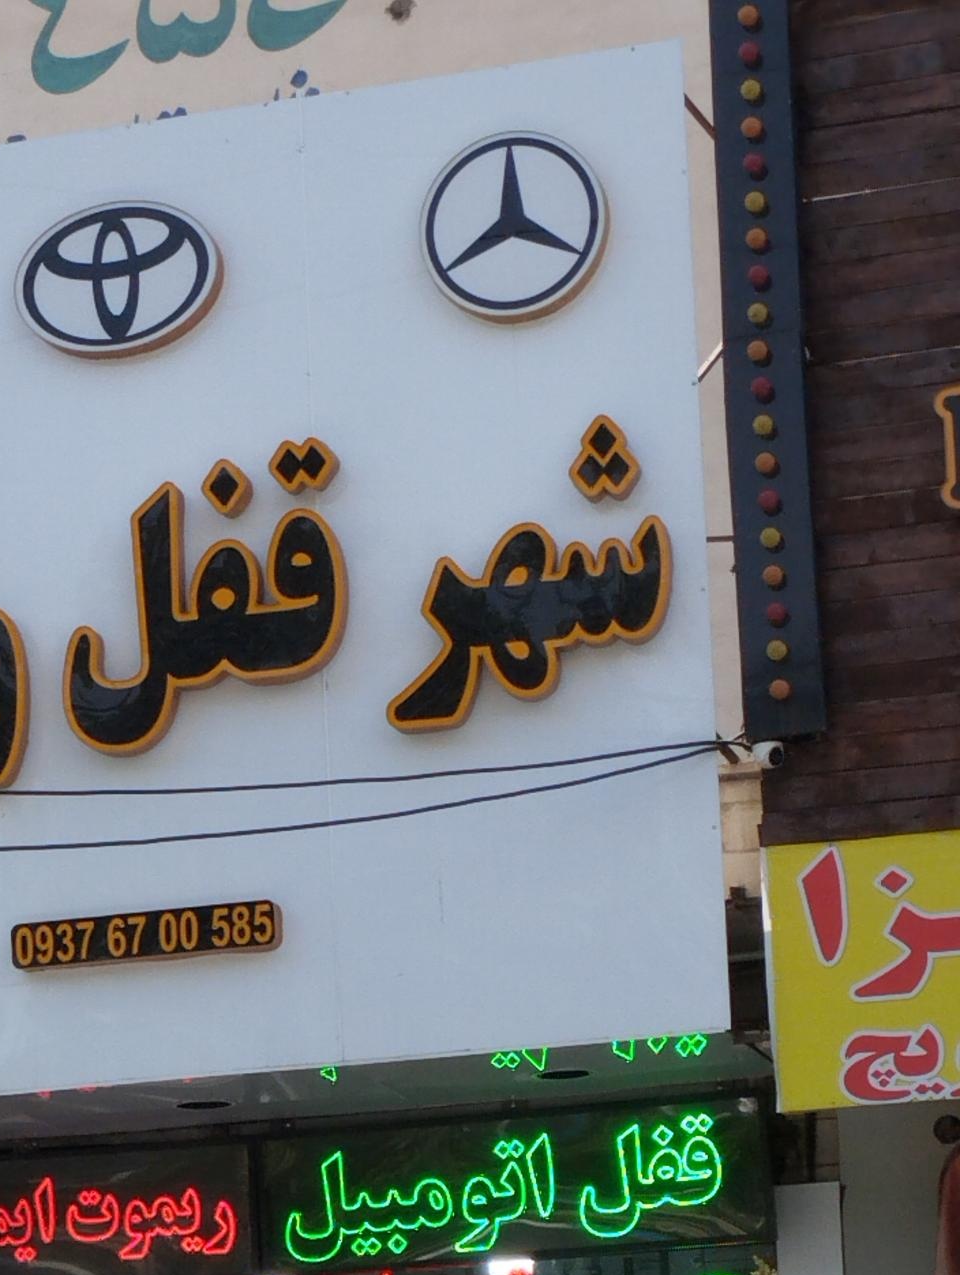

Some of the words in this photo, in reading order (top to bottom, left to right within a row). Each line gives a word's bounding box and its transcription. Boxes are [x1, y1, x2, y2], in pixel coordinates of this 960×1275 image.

[63, 437, 350, 757] قفل
[386, 414, 675, 734] شهر
[14, 920, 95, 967] 0937
[106, 915, 146, 958] 67
[158, 910, 199, 952] 00
[211, 903, 274, 948] 585
[66, 1185, 238, 1260] ریموت
[285, 1132, 556, 1263] اتومبیل
[579, 1112, 723, 1239] قفل
